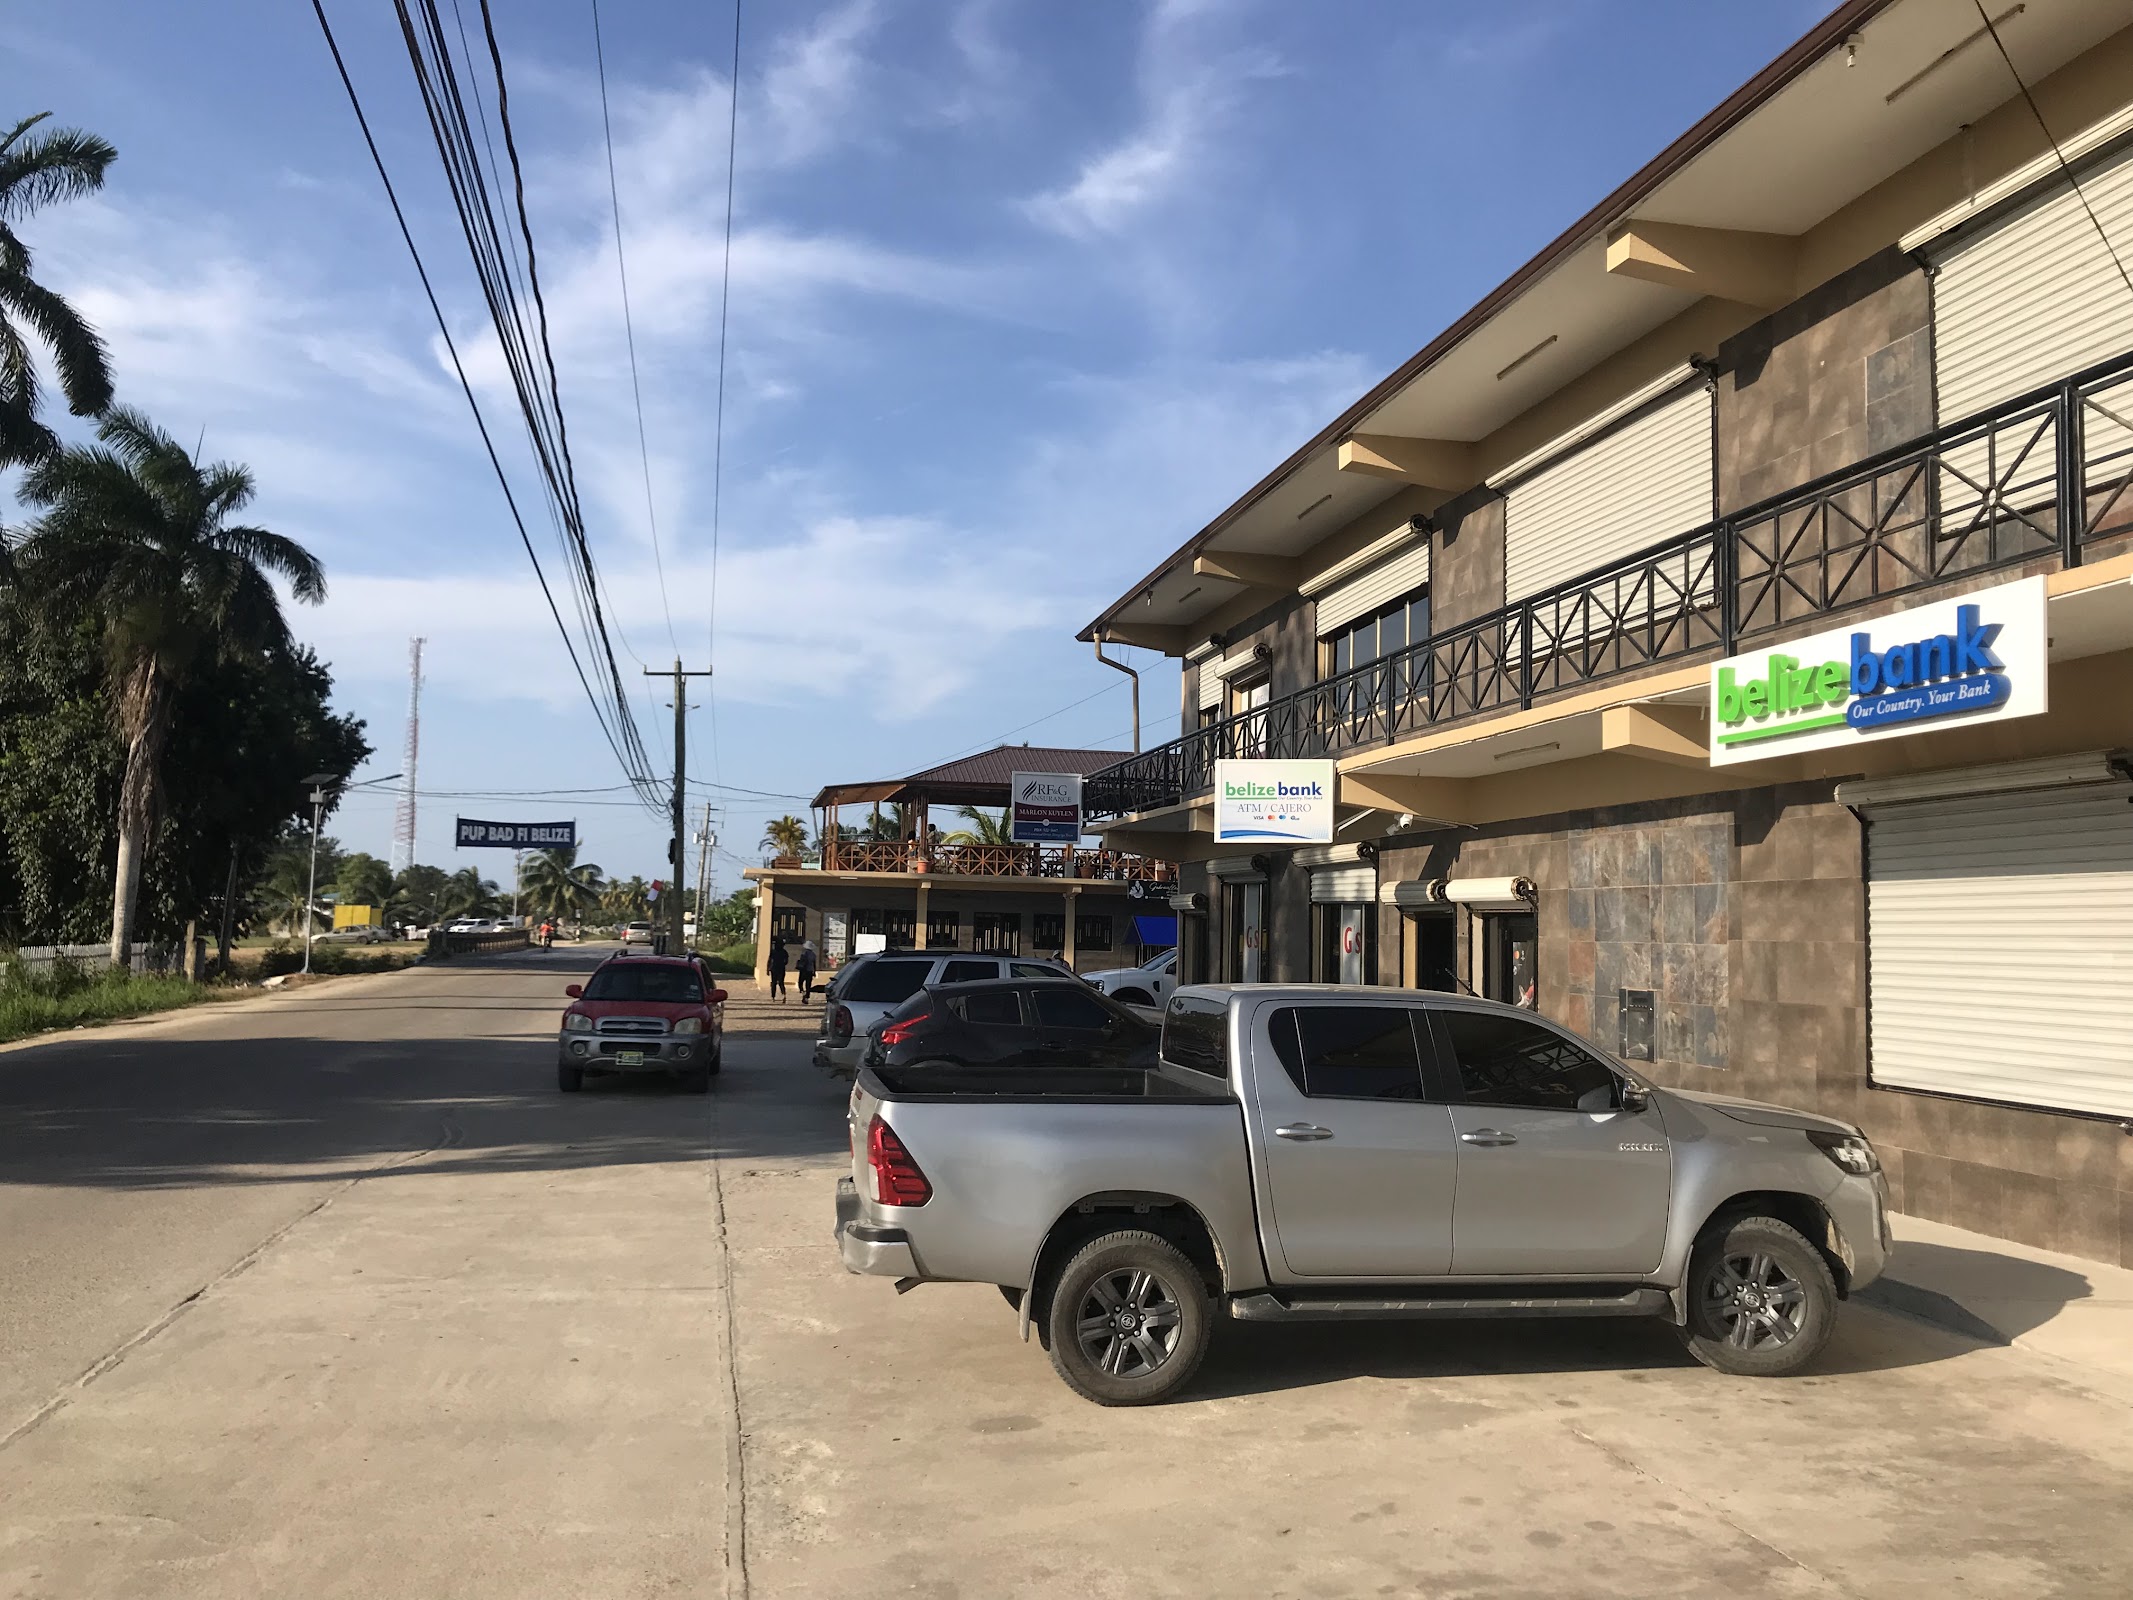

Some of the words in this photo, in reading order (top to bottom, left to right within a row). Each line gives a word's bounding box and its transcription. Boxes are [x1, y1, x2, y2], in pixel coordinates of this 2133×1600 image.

[1718, 654, 1851, 725] belize
[1850, 604, 2006, 696] bank
[1853, 705, 1875, 719] Our
[1877, 699, 1925, 713] Country.
[1928, 690, 1956, 705] Your
[1958, 680, 1991, 700] Bank
[1225, 781, 1276, 796] belize
[1278, 781, 1323, 796] bank
[1031, 795, 1072, 803] INSURANCE
[1019, 808, 1048, 816] MARLON
[1237, 803, 1262, 813] ATM
[1270, 803, 1312, 815] CAJERO
[460, 825, 486, 840] PUP
[488, 827, 515, 841] BAD
[517, 828, 528, 842] FI
[531, 828, 571, 842] BELIZE
